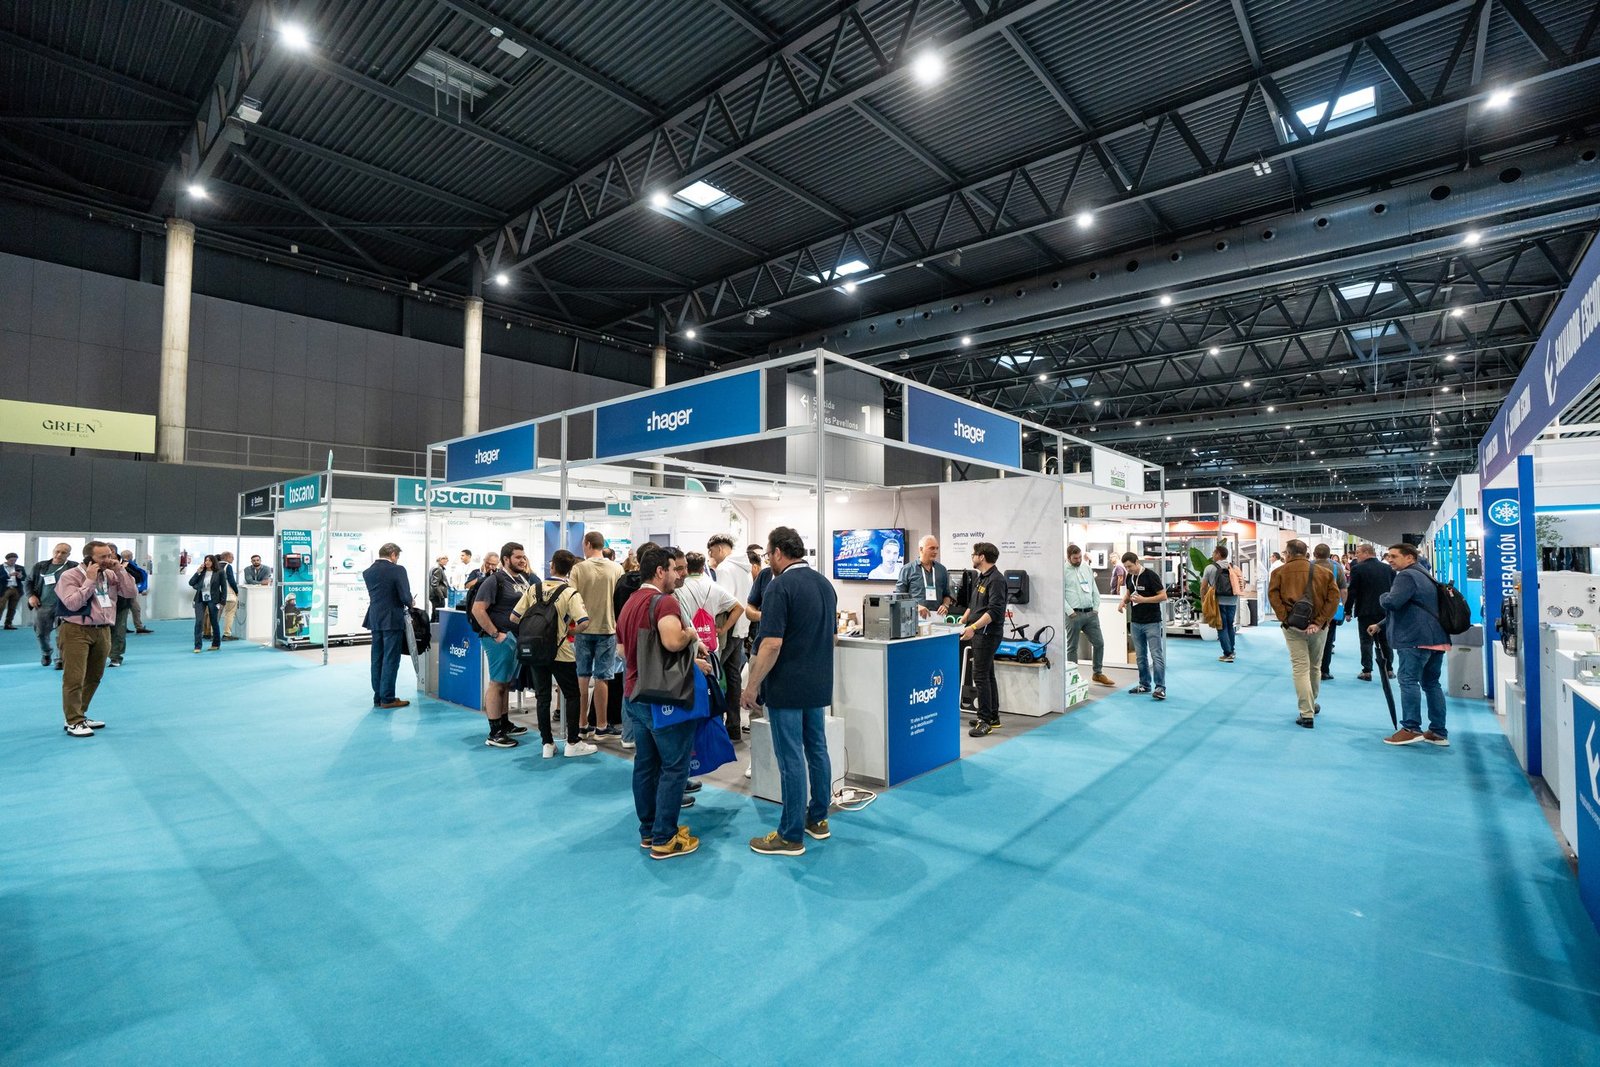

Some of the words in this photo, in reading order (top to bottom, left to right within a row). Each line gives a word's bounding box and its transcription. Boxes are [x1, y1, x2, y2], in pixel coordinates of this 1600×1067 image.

[42, 420, 96, 433] GREEN
[289, 484, 315, 503] toscano
[969, 531, 985, 539] witty
